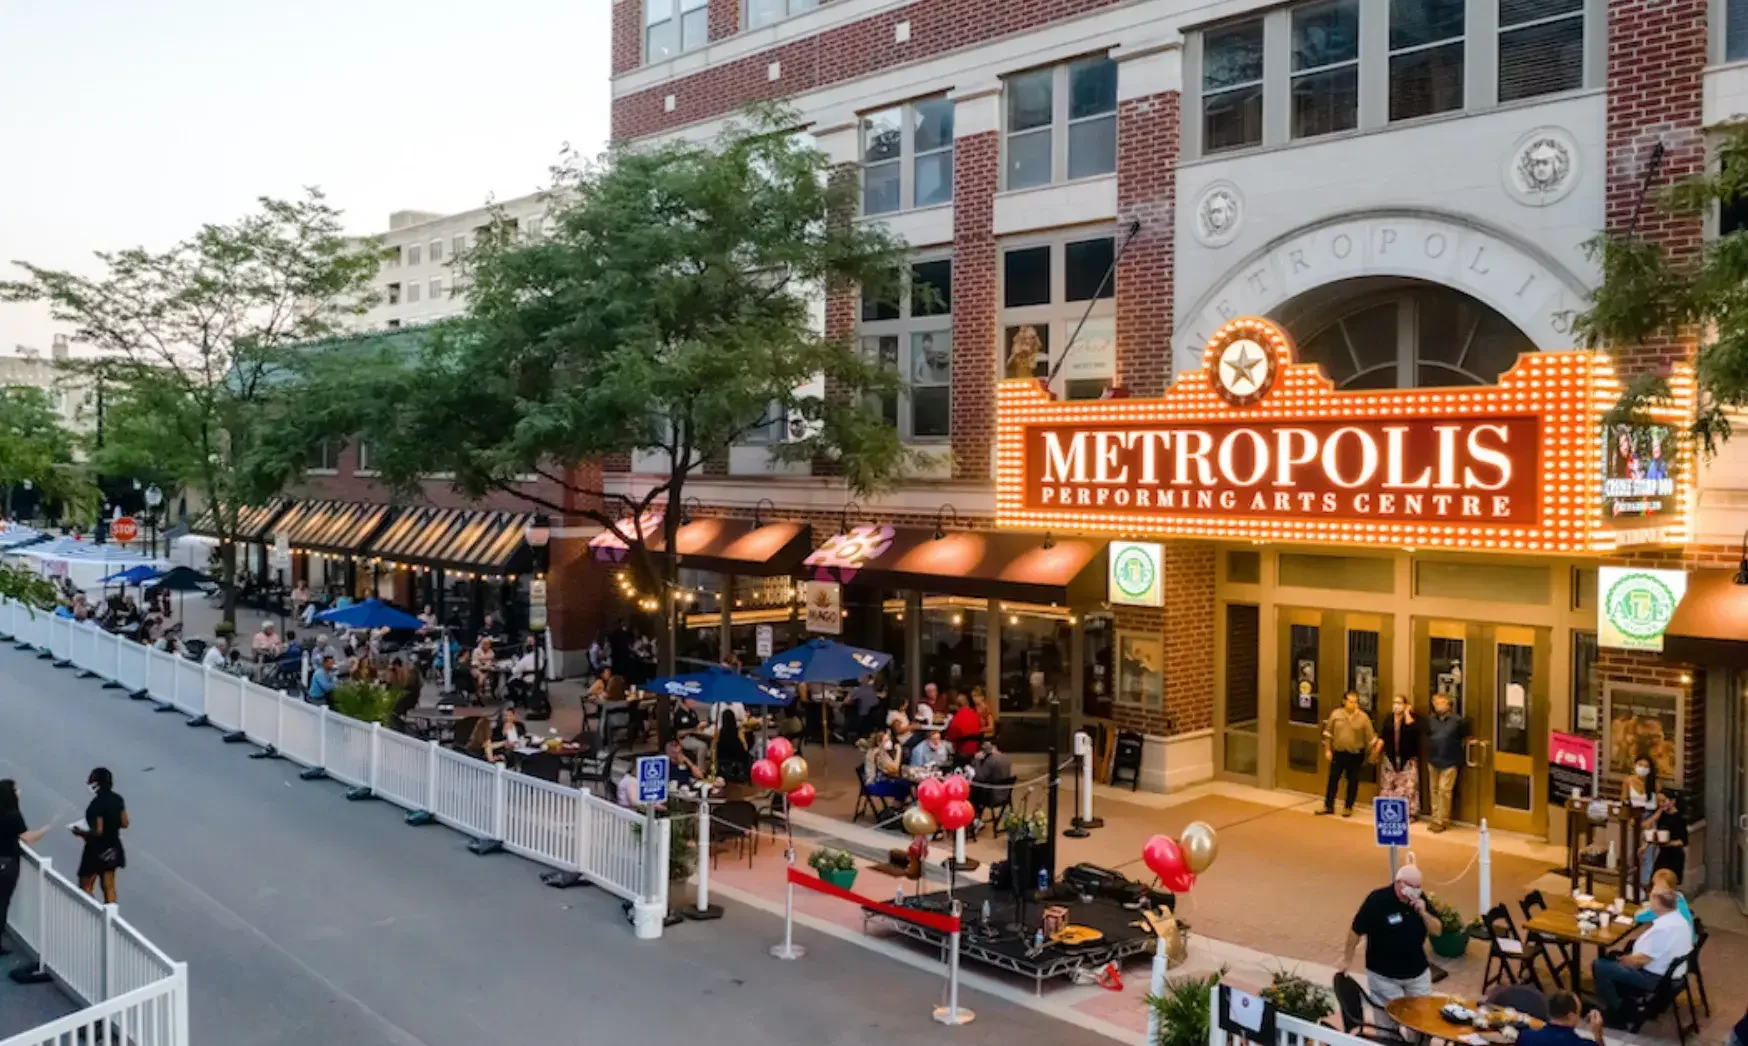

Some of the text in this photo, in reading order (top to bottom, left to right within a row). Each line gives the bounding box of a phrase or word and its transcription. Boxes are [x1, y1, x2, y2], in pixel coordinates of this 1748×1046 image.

[1041, 424, 1512, 490] METROPOLIS
[1042, 486, 1511, 518] PERFORMING ARTS CENTRE
[112, 522, 136, 535] STOP
[1378, 822, 1407, 830] ACCESS
